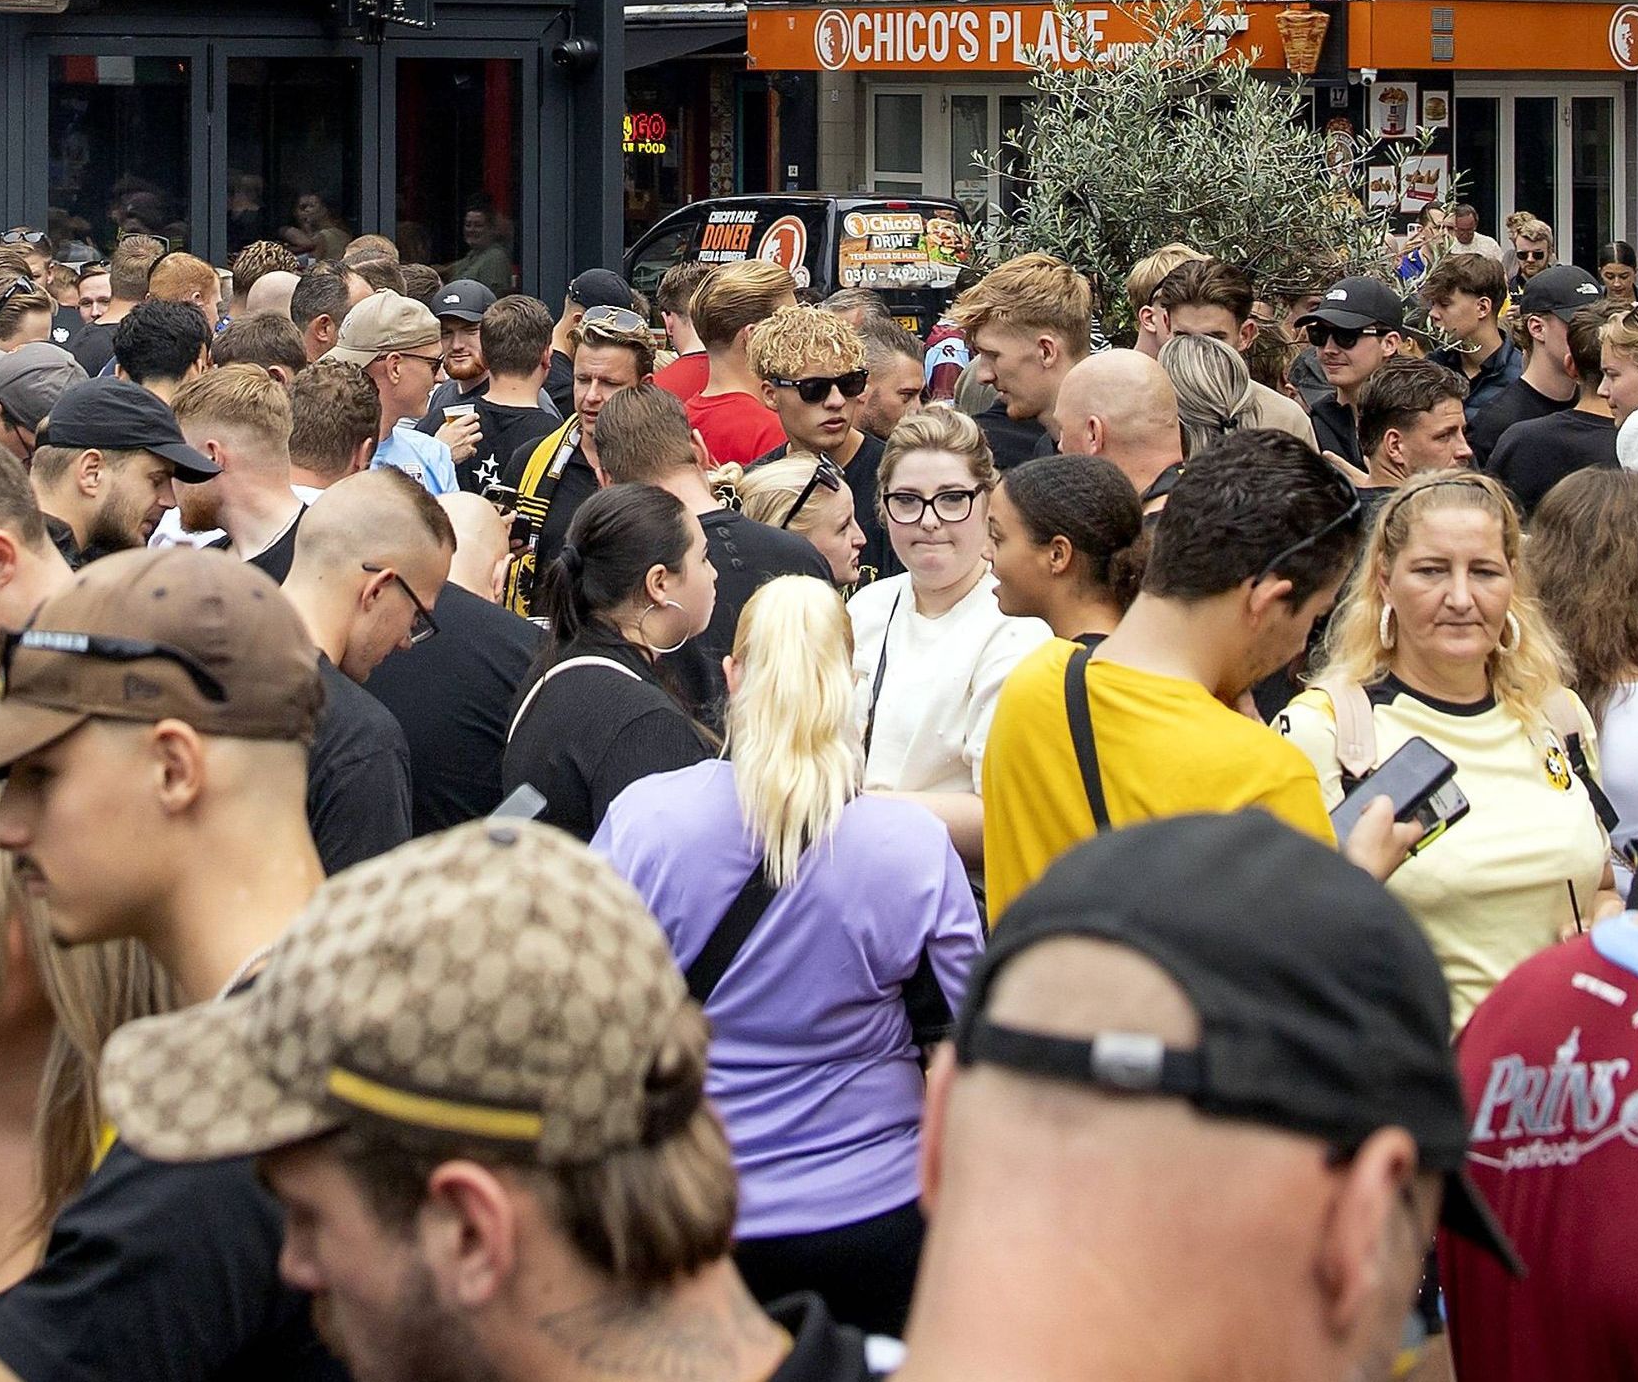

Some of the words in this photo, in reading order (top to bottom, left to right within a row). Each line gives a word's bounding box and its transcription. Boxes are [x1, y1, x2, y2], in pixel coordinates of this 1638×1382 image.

[852, 11, 979, 63] CHICO'S
[1332, 89, 1345, 102] 17
[870, 217, 921, 232] Chico's
[701, 224, 752, 250] DONER
[873, 234, 913, 248] DRIVE
[845, 268, 877, 282] 0316
